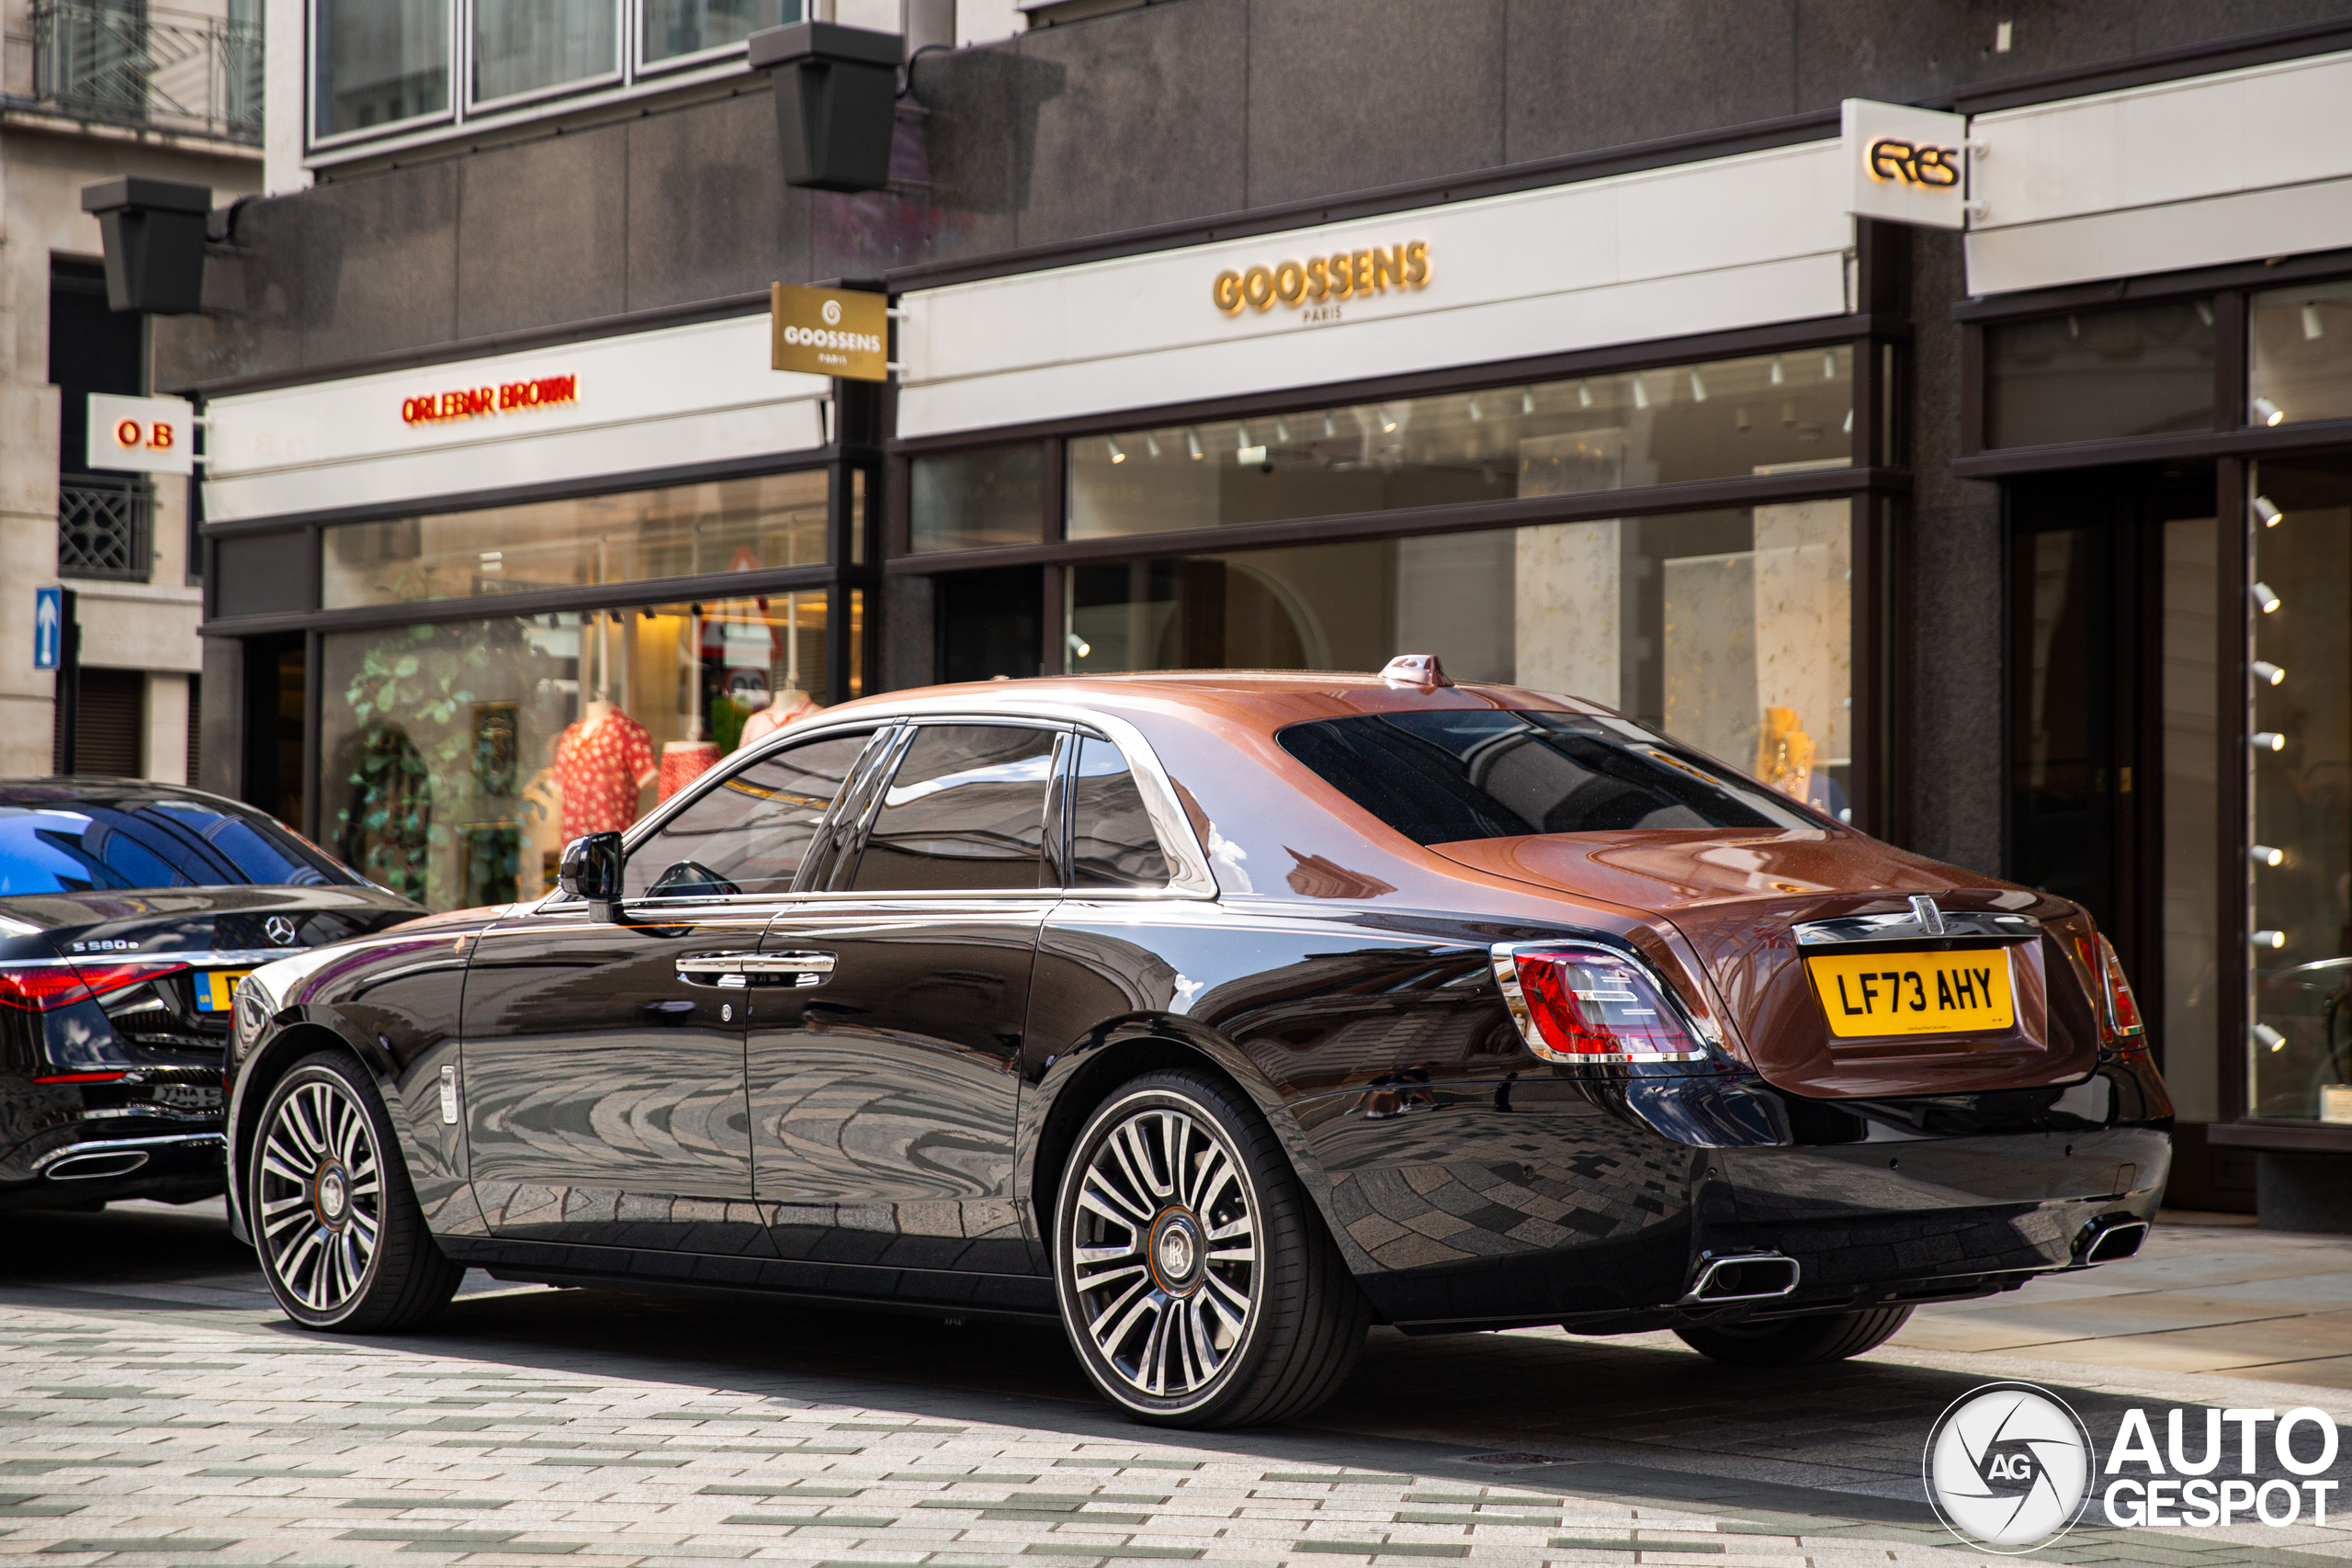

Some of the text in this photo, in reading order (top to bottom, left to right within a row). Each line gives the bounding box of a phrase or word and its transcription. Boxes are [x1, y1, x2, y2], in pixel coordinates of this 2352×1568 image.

[1871, 140, 1960, 186] ERES
[1213, 240, 1430, 313] GOOSSENS
[1303, 306, 1342, 323] PARIS
[784, 325, 881, 354] GOOSSENS
[818, 353, 847, 366] PARIS
[402, 375, 576, 423] ORLEBAR BROWN
[1837, 967, 1993, 1015] LF73 AHY
